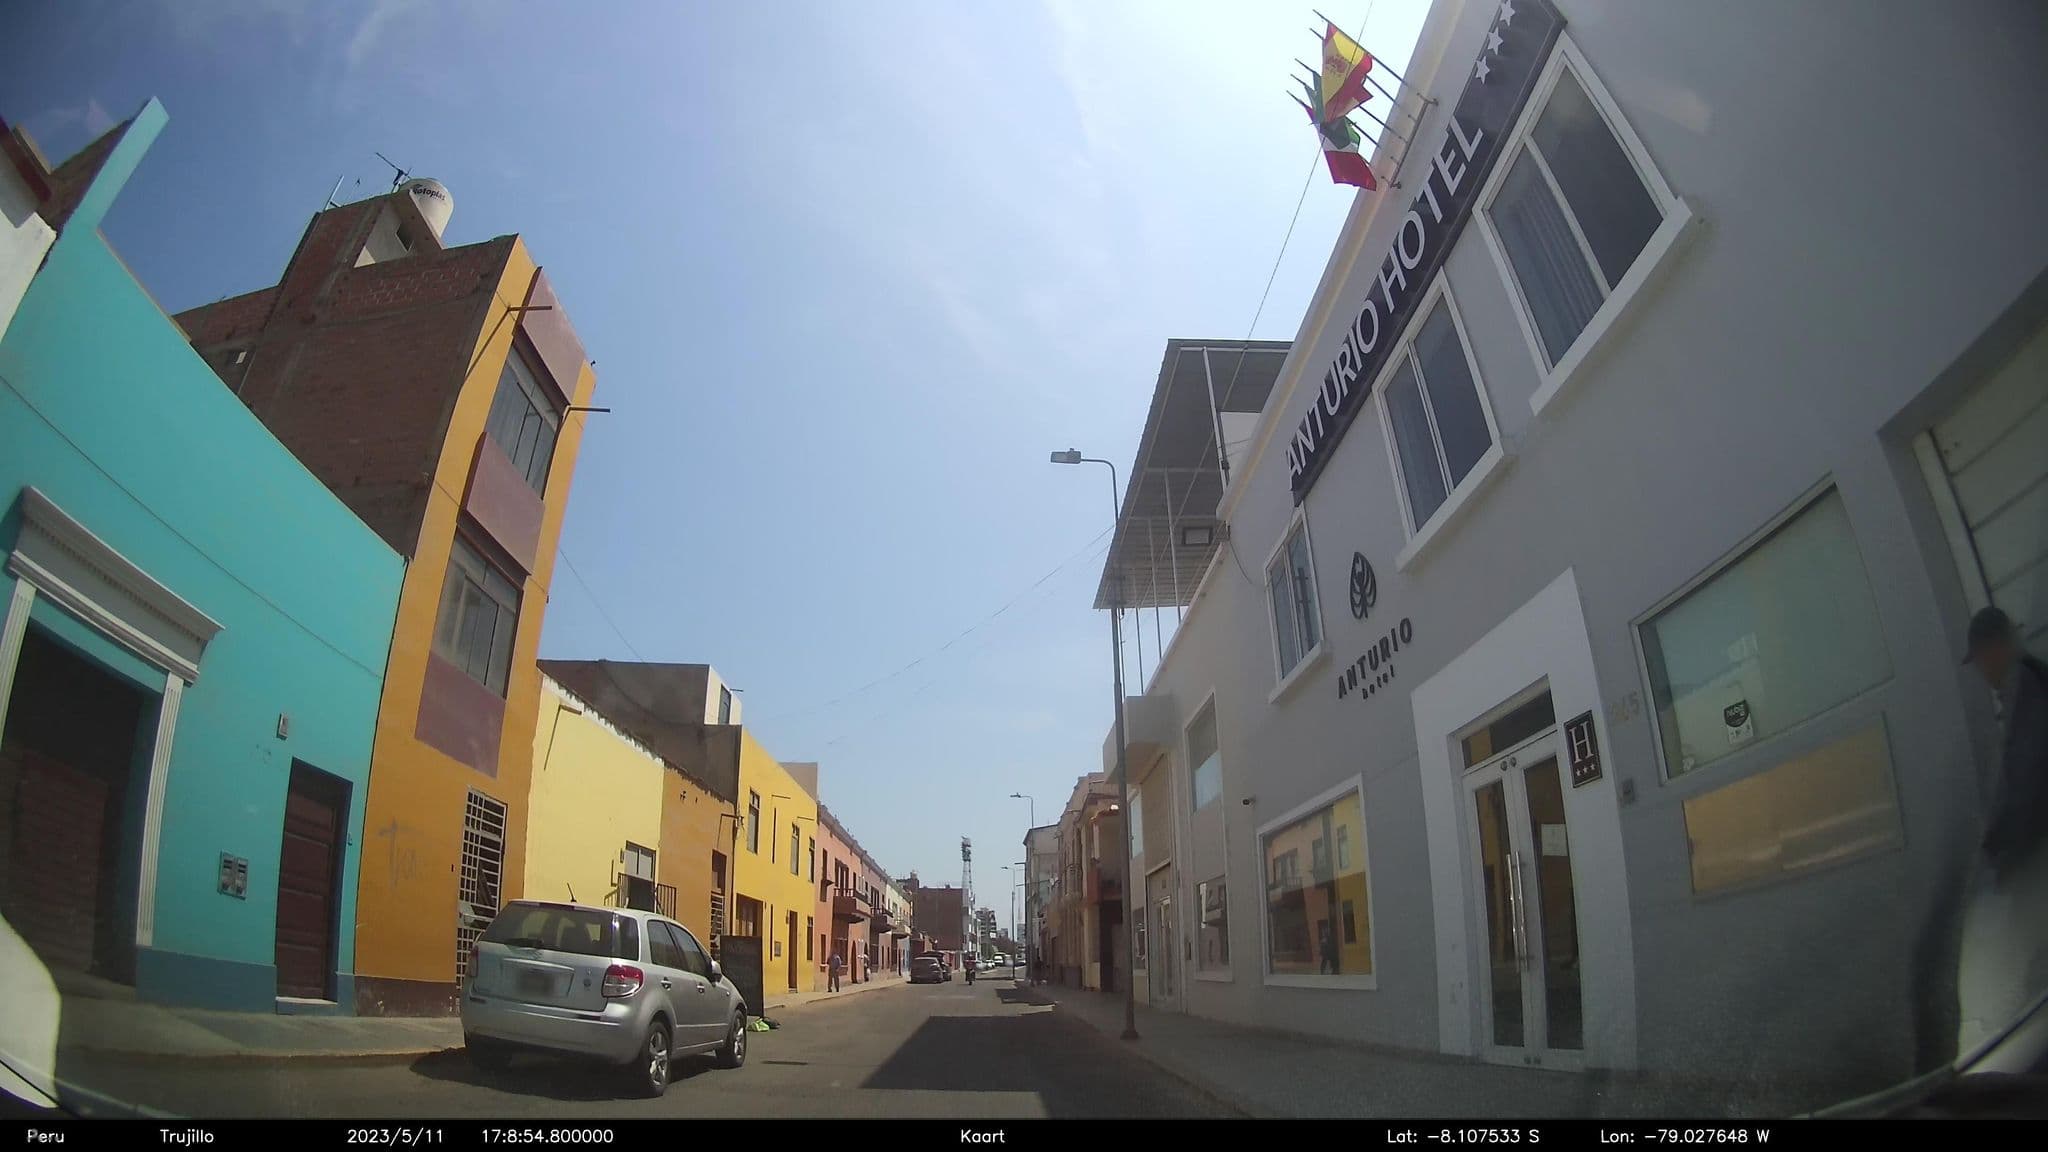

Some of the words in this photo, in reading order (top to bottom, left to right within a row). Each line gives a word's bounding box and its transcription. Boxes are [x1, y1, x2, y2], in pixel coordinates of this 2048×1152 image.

[1286, 299, 1380, 490] ANTURIO
[1378, 117, 1485, 314] HOTEL
[1338, 618, 1413, 699] ANTURIO
[1361, 664, 1395, 700] hotel
[1568, 720, 1596, 764] H
